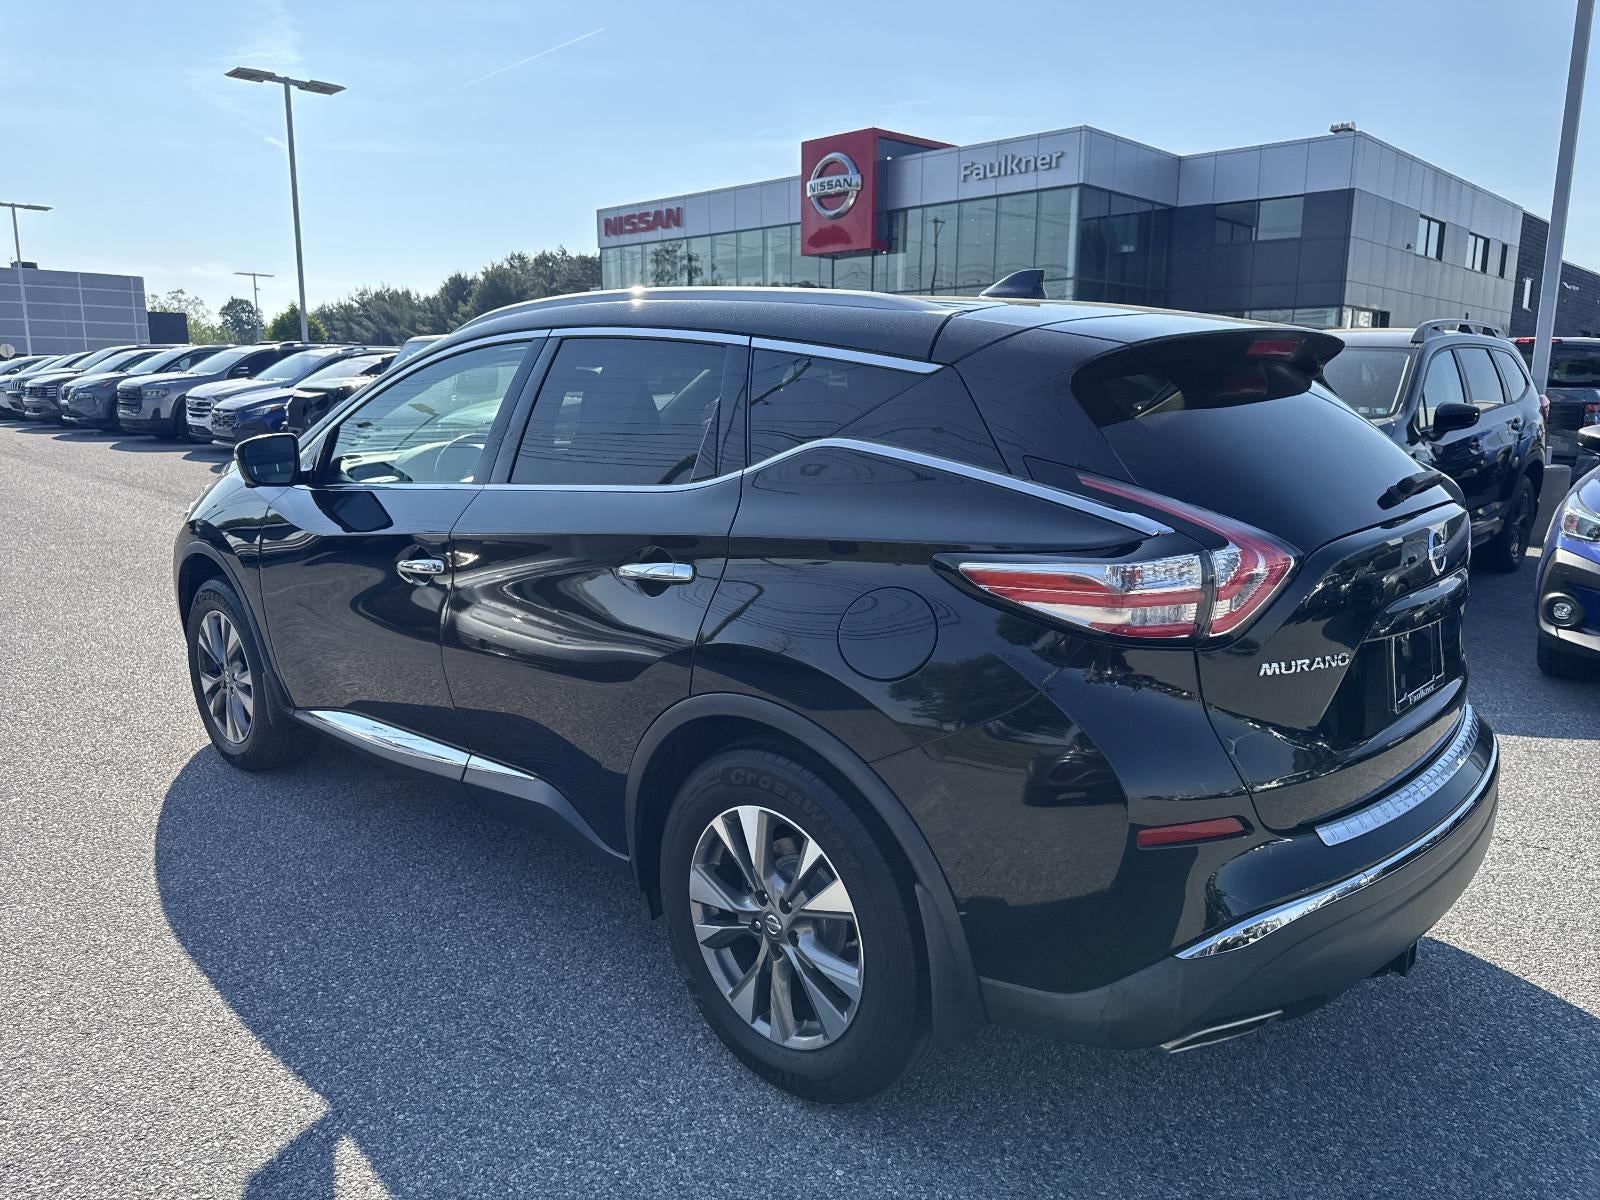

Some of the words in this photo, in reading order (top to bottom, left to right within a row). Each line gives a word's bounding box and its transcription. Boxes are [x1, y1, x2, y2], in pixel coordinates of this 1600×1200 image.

[960, 151, 1064, 182] Faulkner
[809, 177, 852, 193] NISSAN
[604, 207, 684, 237] NISSAN
[1259, 652, 1349, 677] MURANO
